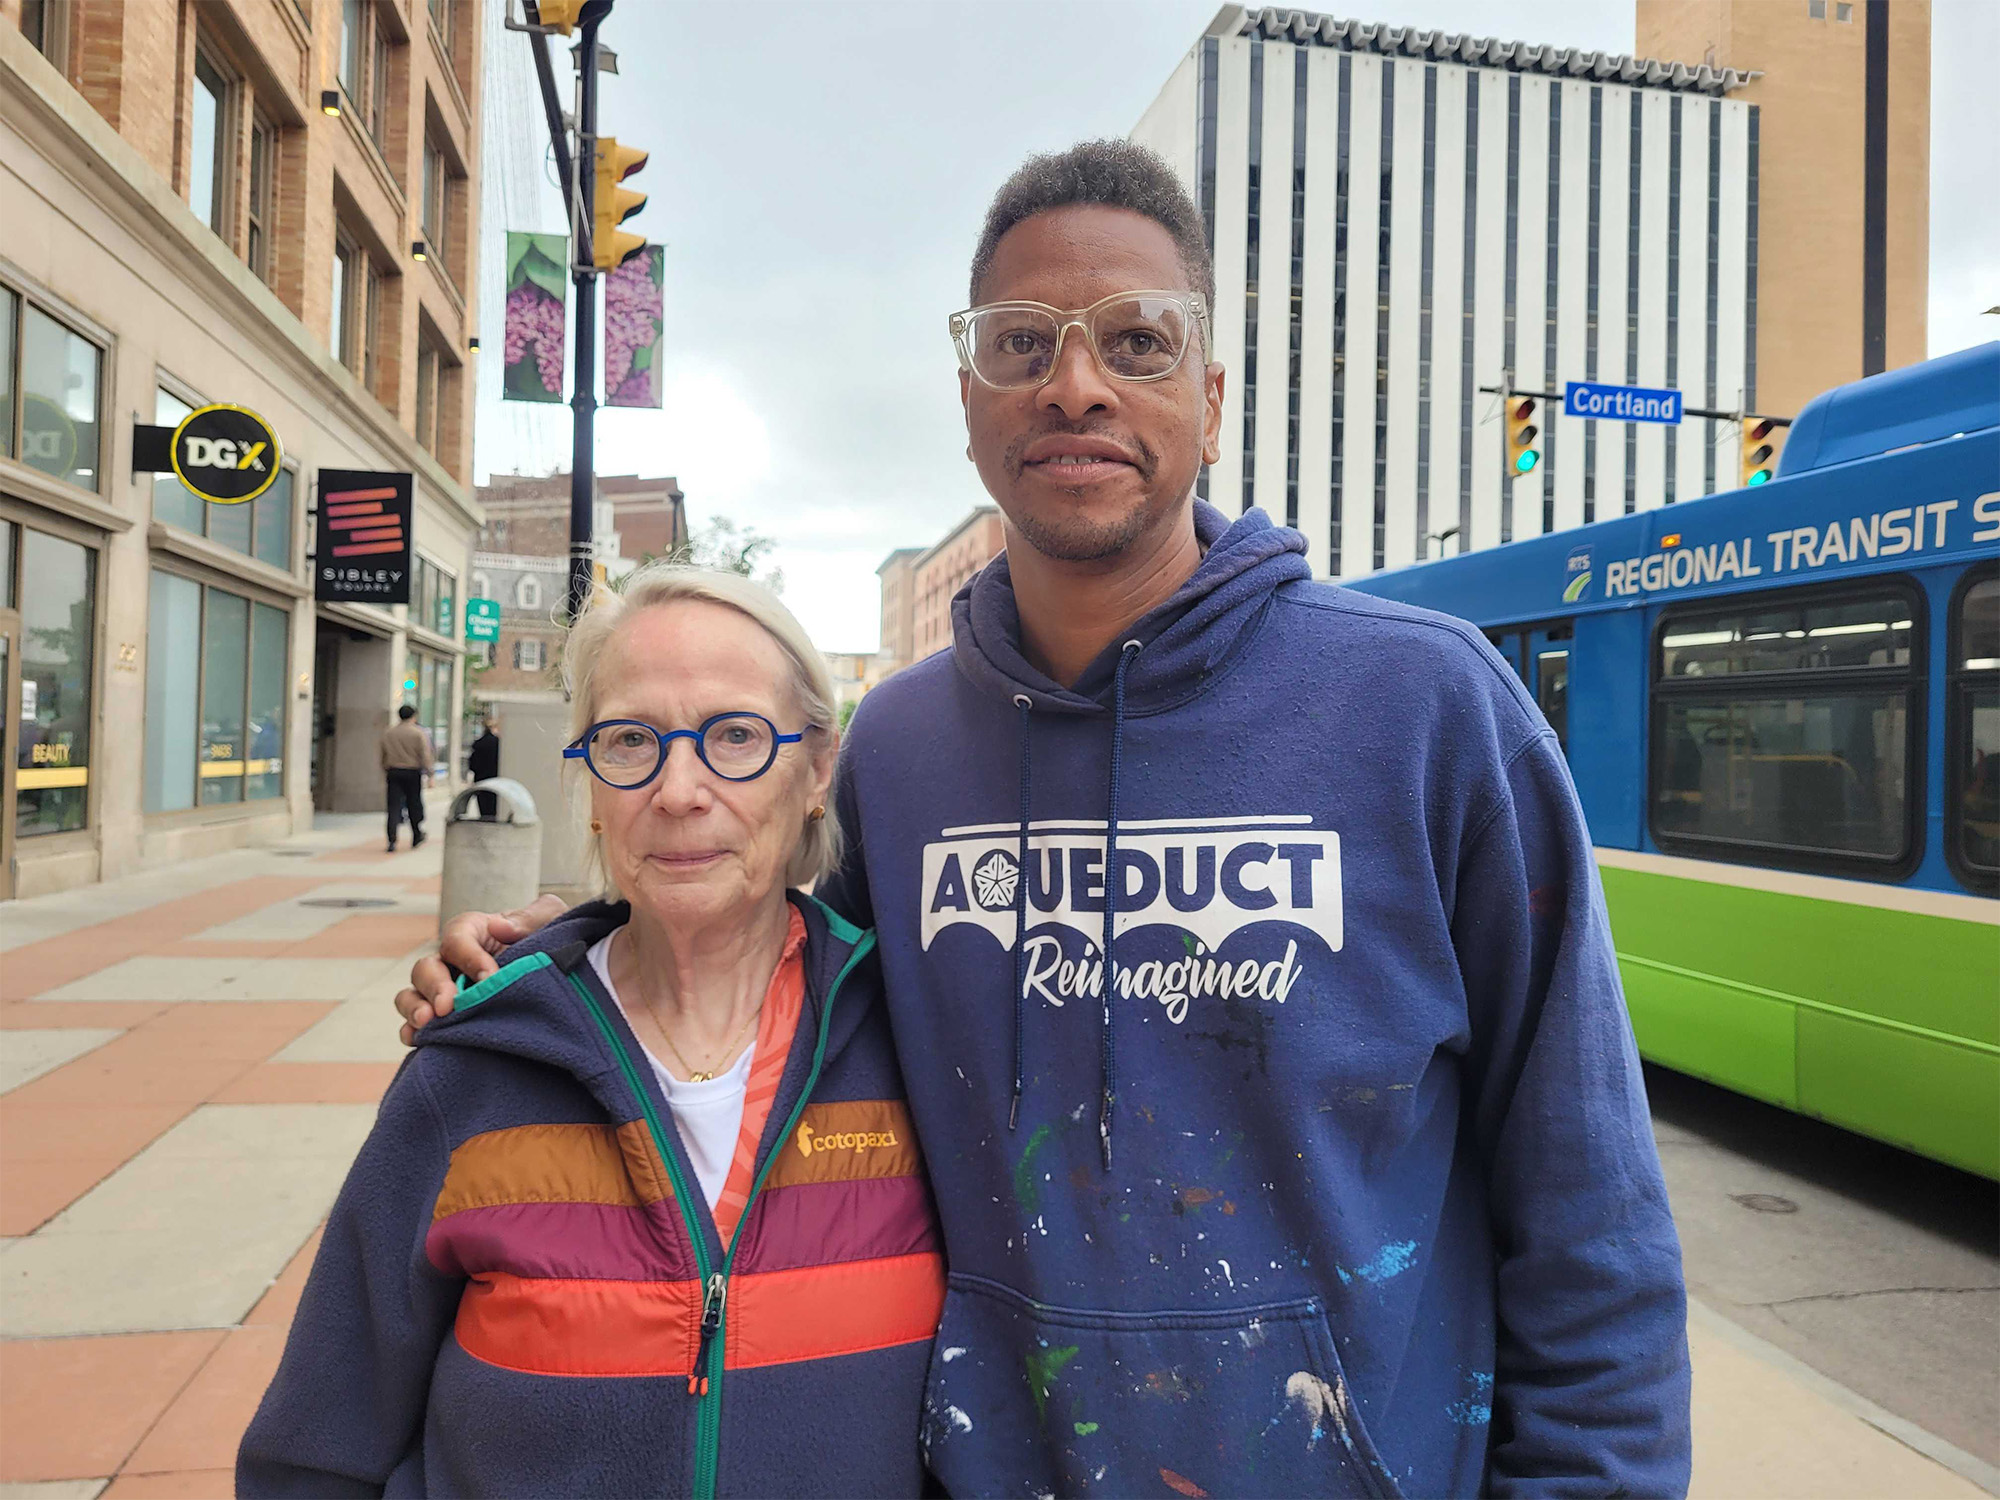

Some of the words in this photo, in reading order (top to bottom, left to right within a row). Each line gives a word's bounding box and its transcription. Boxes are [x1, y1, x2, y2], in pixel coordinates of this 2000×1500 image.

[1573, 386, 1676, 420] Cortland
[185, 435, 267, 472] DGX
[1605, 537, 1762, 598] REGIONAL
[1767, 499, 1959, 573] TRANSIT
[322, 567, 403, 583] SIBLEY
[32, 743, 71, 763] BEAUTY
[930, 840, 1325, 915] AQUEDUCT
[1022, 934, 1303, 1025] Reimagined
[812, 1129, 899, 1154] cotopaxi
